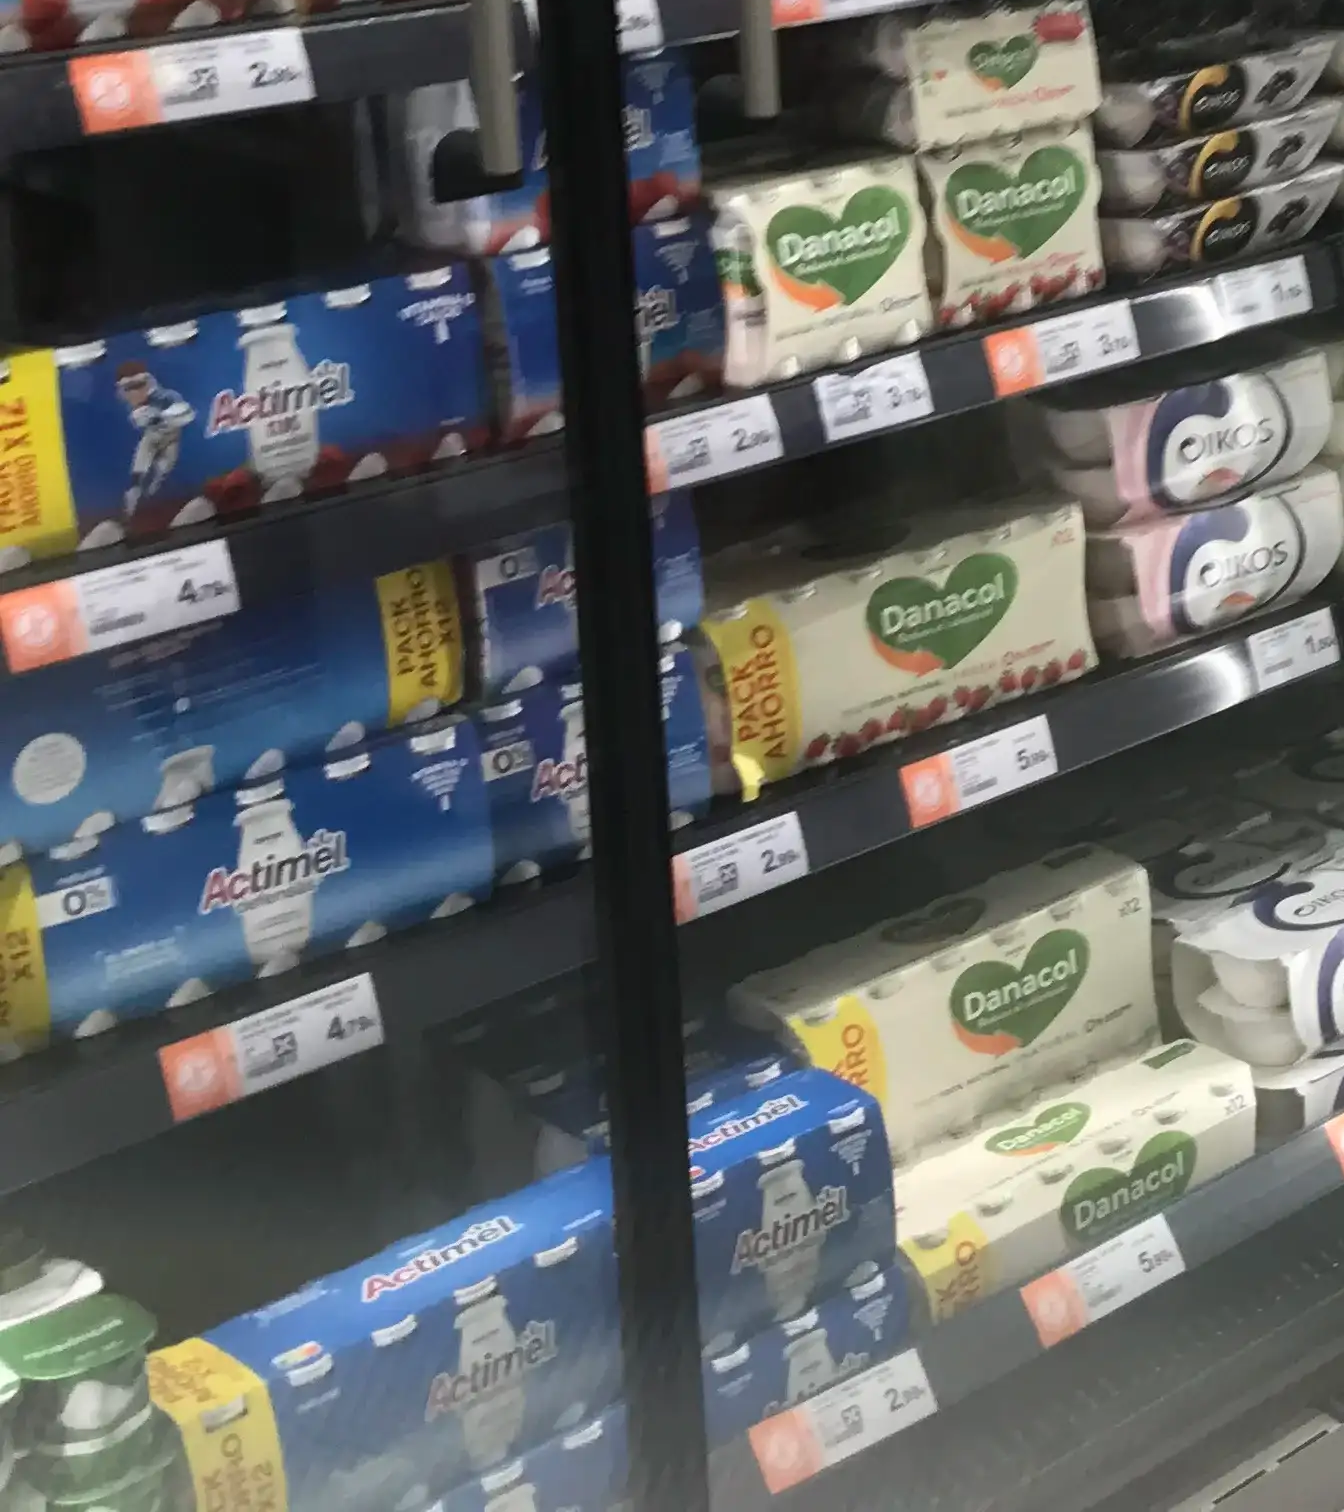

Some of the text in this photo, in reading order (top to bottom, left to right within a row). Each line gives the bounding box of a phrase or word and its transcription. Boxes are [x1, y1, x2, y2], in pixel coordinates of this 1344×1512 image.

[955, 165, 1077, 221] Danacol
[777, 206, 902, 268] Danacol
[208, 360, 353, 438] Actimel
[1179, 418, 1275, 465] OIKOS
[1199, 540, 1289, 589] OIKOS
[389, 596, 416, 676] PACK
[405, 567, 439, 689] AHORRO
[880, 573, 1005, 638] Danacol
[737, 654, 764, 744] PACK
[750, 623, 787, 760] AHORRO
[202, 829, 350, 915] Actimel
[963, 948, 1080, 1023] Danacol
[687, 1092, 810, 1153] Actimel
[997, 1106, 1083, 1151] Danacol
[732, 1185, 848, 1275] Actimel
[1074, 1151, 1187, 1231] Danacol
[362, 1215, 518, 1303] Actimel
[426, 1322, 557, 1421] Actimel
